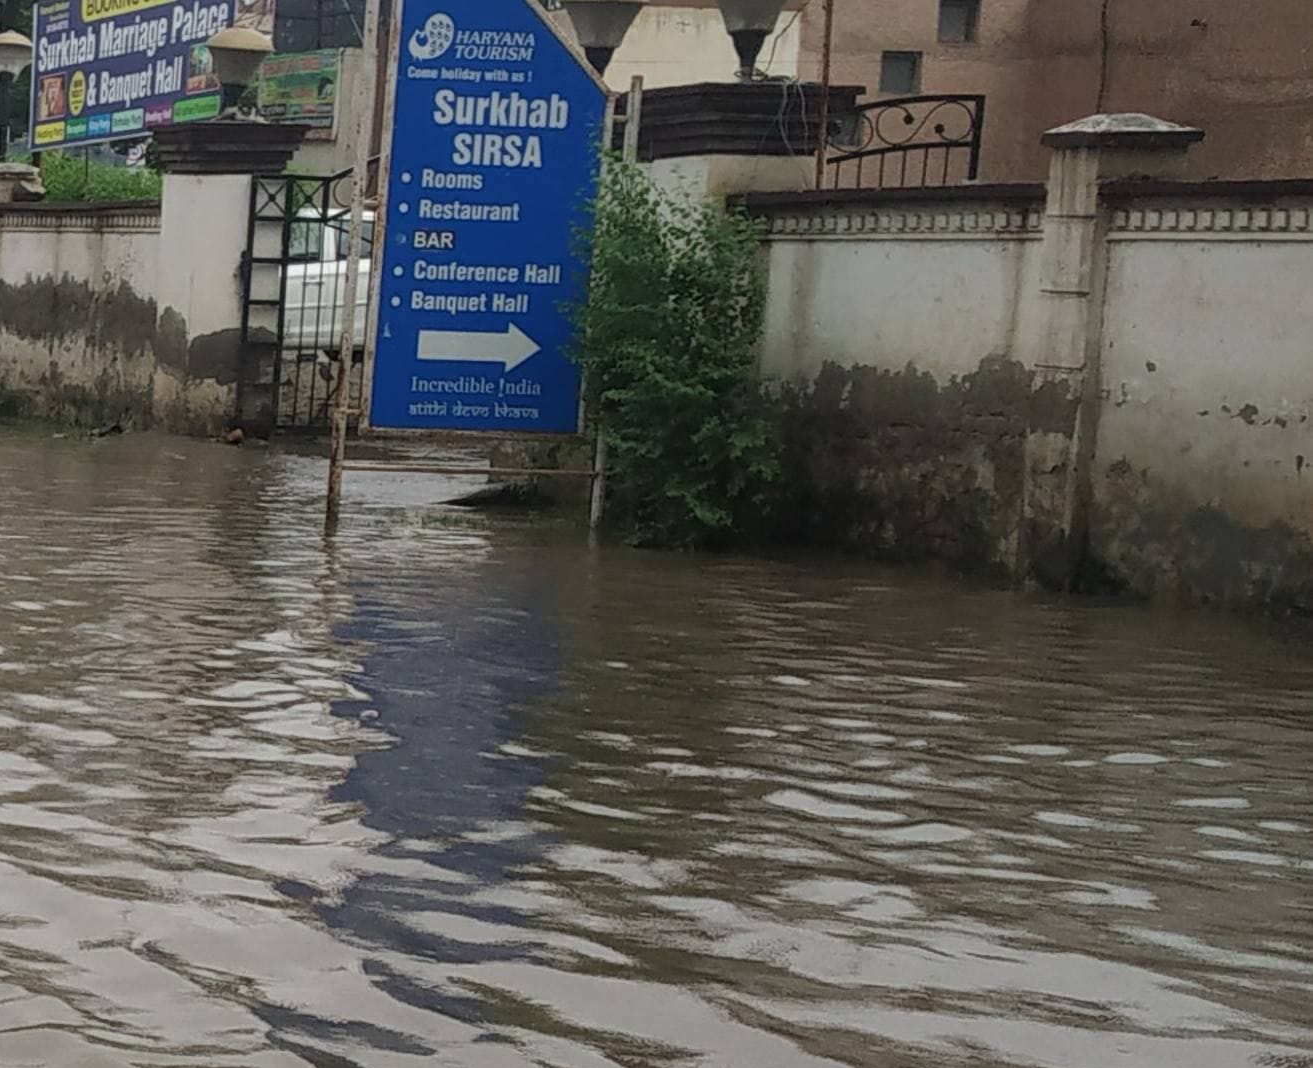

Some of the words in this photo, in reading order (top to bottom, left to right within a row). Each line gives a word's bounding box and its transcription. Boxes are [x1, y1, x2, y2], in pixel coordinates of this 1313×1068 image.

[37, 25, 95, 72] Surkhab
[99, 15, 168, 58] Marriage
[171, 1, 229, 44] Palace
[454, 31, 536, 47] HARYANA
[454, 46, 534, 61] TOURISM
[86, 72, 99, 107] &
[99, 64, 153, 108] Banquet
[155, 56, 184, 95] Hall
[407, 66, 438, 79] Come
[441, 67, 481, 83] holiday
[484, 69, 509, 82] with
[512, 72, 524, 82] us
[433, 89, 569, 130] Surkhab
[452, 132, 542, 168] SIRSA
[421, 168, 483, 190] Rooms
[419, 199, 520, 222] Restaurant
[413, 231, 455, 249] BAR
[413, 260, 519, 282] Conference
[524, 263, 560, 284] Hall
[411, 291, 487, 316] Banquet
[492, 293, 529, 313] Hall
[411, 376, 495, 395] Incredible
[408, 401, 447, 417] atithi
[451, 400, 489, 417] devo
